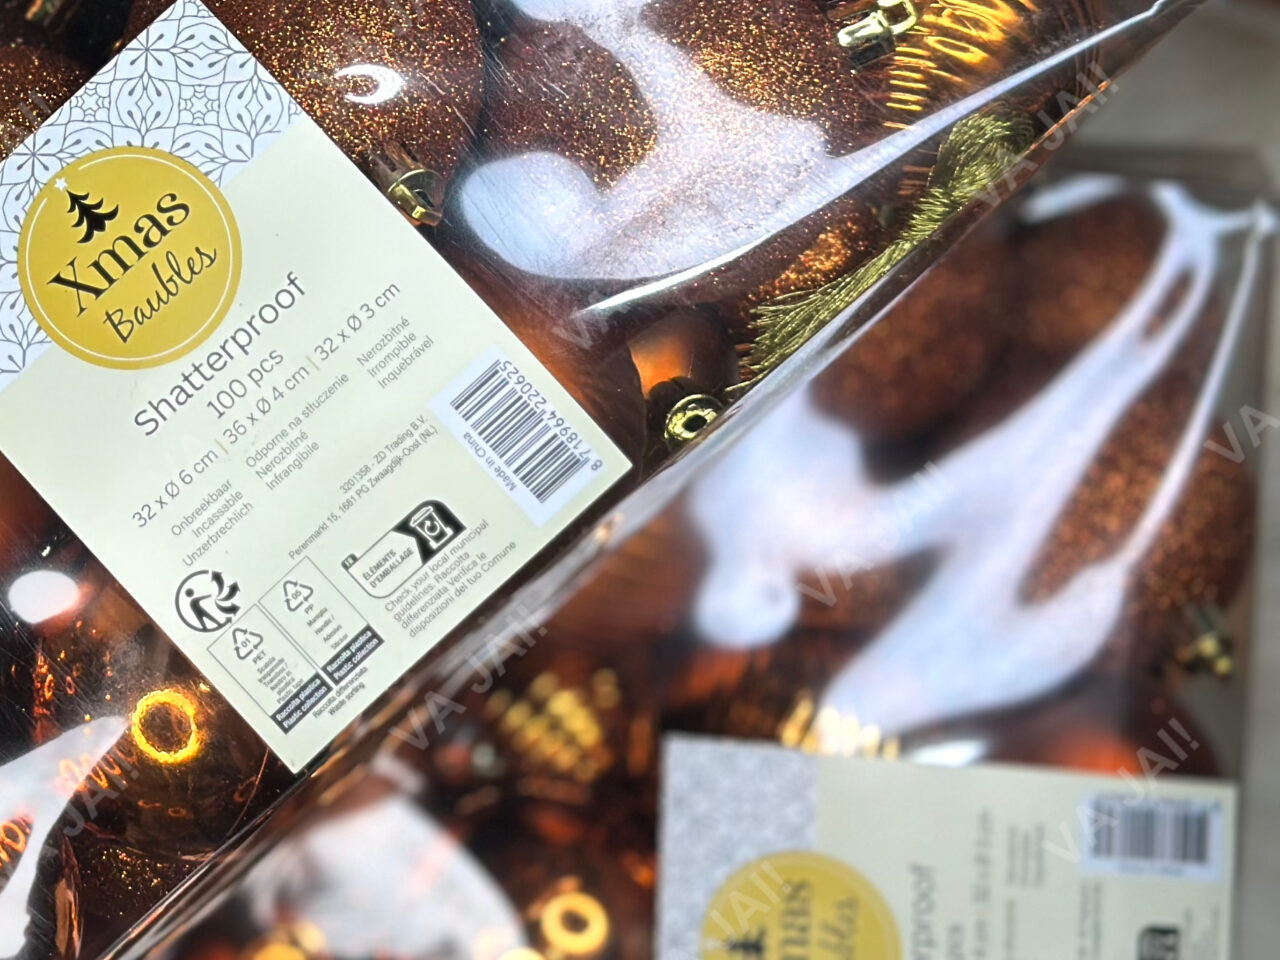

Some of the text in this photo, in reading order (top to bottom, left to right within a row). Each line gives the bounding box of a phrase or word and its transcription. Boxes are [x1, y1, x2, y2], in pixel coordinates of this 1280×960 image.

[45, 192, 190, 317] Xmas
[102, 245, 217, 344] Baubles
[133, 270, 305, 436] Shatterproof
[355, 315, 410, 366] Nerozbitné
[366, 332, 417, 377] Irrompible
[376, 334, 434, 389] Inquebrável
[131, 503, 157, 528] 32
[154, 494, 168, 509] x
[178, 468, 193, 485] 6
[192, 449, 219, 474] cm
[221, 418, 247, 445] 36
[245, 411, 259, 426] x
[271, 385, 284, 401] 4
[283, 365, 310, 391] cm
[313, 336, 339, 361] 32
[336, 328, 350, 343] x
[359, 302, 375, 319] 3
[374, 283, 400, 308] cm
[206, 349, 284, 419] 100 pcs
[244, 428, 289, 468] Odporne
[287, 416, 303, 430] na
[301, 373, 349, 418] stłuczenie
[498, 359, 603, 471] 8 718964 220625
[254, 428, 309, 479] Nerozbitné
[264, 441, 319, 491] Infrangibile
[354, 483, 370, 498] PG
[366, 438, 422, 488] Zwaagdijk-Oost
[418, 424, 438, 443] (NL)
[372, 450, 387, 464] ZD
[383, 428, 414, 453] Trading
[462, 431, 517, 491] Made in China
[170, 479, 232, 536] Onbreekbaar
[181, 501, 254, 567] Unzerbrechlich
[190, 490, 243, 538] Incassable
[368, 546, 414, 588] D'EMBALLAGE
[383, 517, 489, 612] Check your local municipal
[400, 551, 487, 629] differenziata Verifica le
[408, 541, 516, 638] disposizioni del tuo Comune
[432, 551, 470, 584] Raccolta
[303, 603, 314, 615] PP
[251, 649, 266, 664] PET
[325, 630, 372, 673] Raccolta plastica
[332, 637, 379, 680] Plastic collection
[275, 677, 321, 721] Raccolta plastica
[281, 685, 327, 728] Plastic collection
